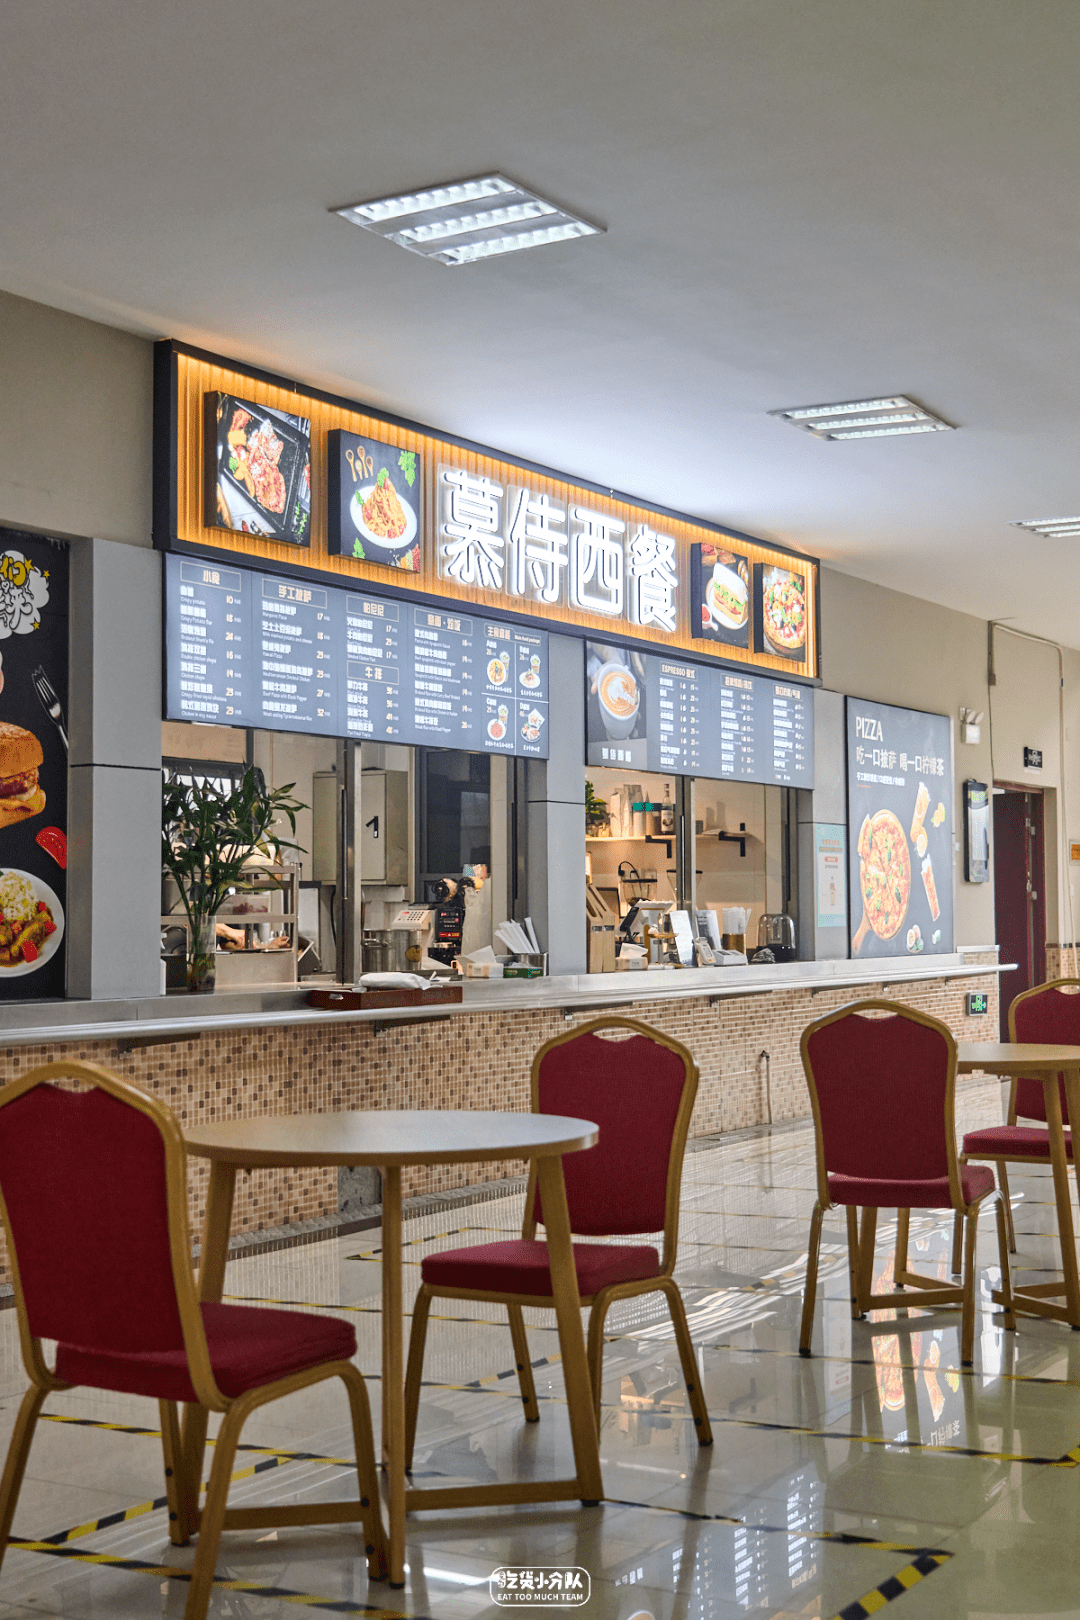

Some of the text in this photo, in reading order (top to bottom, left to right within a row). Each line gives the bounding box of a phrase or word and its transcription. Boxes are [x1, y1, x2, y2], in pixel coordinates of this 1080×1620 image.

[444, 471, 679, 632] 慕侍西餐
[363, 601, 384, 616] 帕尼尼
[661, 664, 685, 676] ESPRESSO
[856, 716, 884, 742] PIZZA
[856, 745, 945, 776] 吃一口披萨 喝一口柠檬茶
